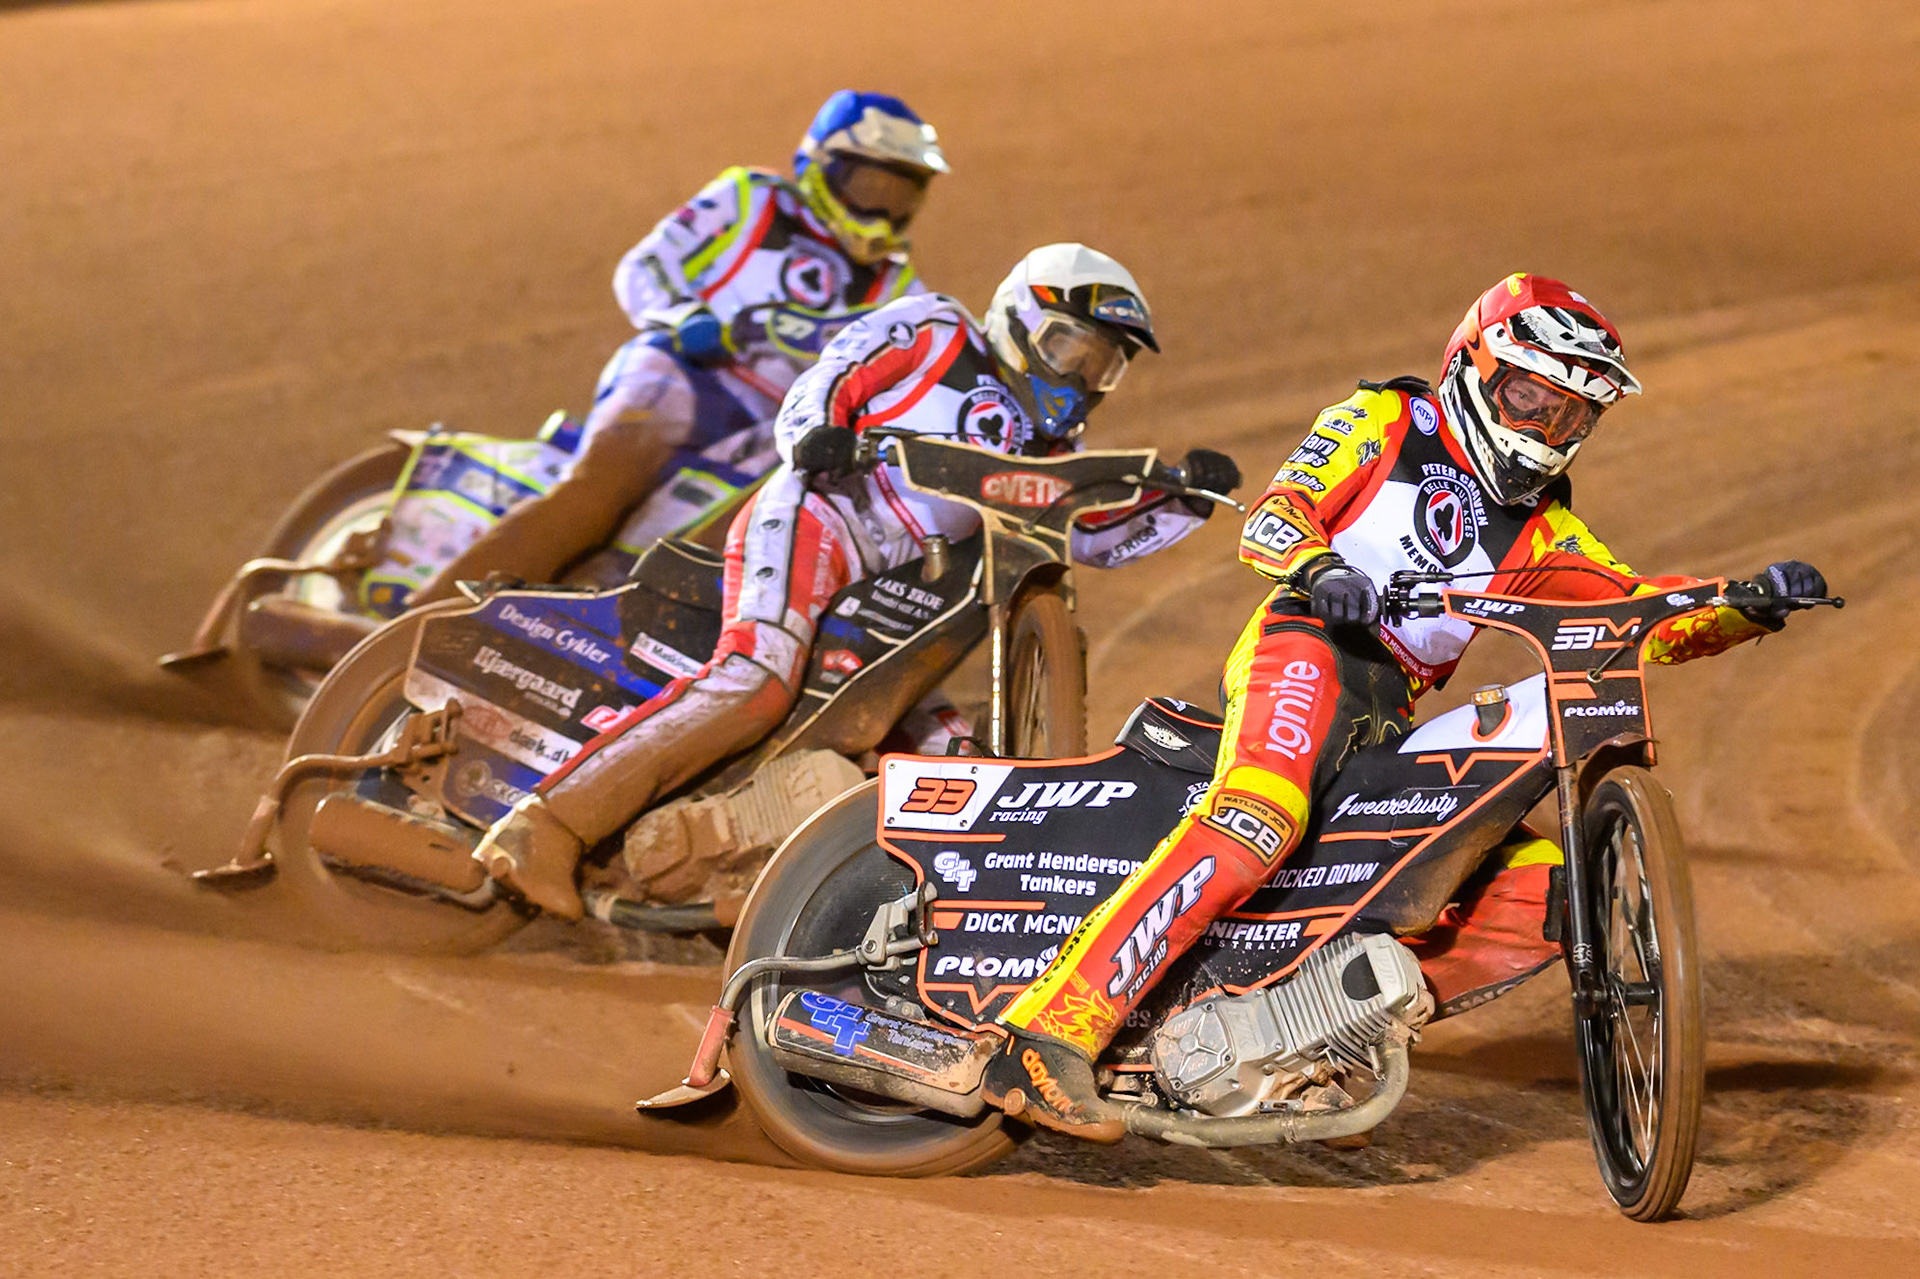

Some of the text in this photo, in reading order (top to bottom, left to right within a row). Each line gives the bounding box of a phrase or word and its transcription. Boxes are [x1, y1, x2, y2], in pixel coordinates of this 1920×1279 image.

[1421, 463, 1489, 527] PETER CRAVEN
[1423, 481, 1473, 539] BELLE VUE ACES
[1243, 511, 1303, 551] JCB
[1465, 599, 1525, 615] JWP
[498, 603, 556, 640] Design
[555, 630, 611, 664] Cykler
[900, 777, 1138, 815] 33 JWP
[1224, 796, 1268, 817] WATLING
[989, 807, 1048, 824] racing
[1211, 808, 1281, 856] JCB
[984, 851, 1143, 876] Grant Henderson
[1325, 862, 1379, 885] DOWN
[1020, 874, 1097, 896] Tankers
[964, 912, 1018, 933] DICK
[1107, 855, 1216, 998] JWP
[1202, 921, 1301, 941] NIFILTER
[1204, 938, 1297, 950] USTRALIA
[1125, 936, 1168, 1001] racing
